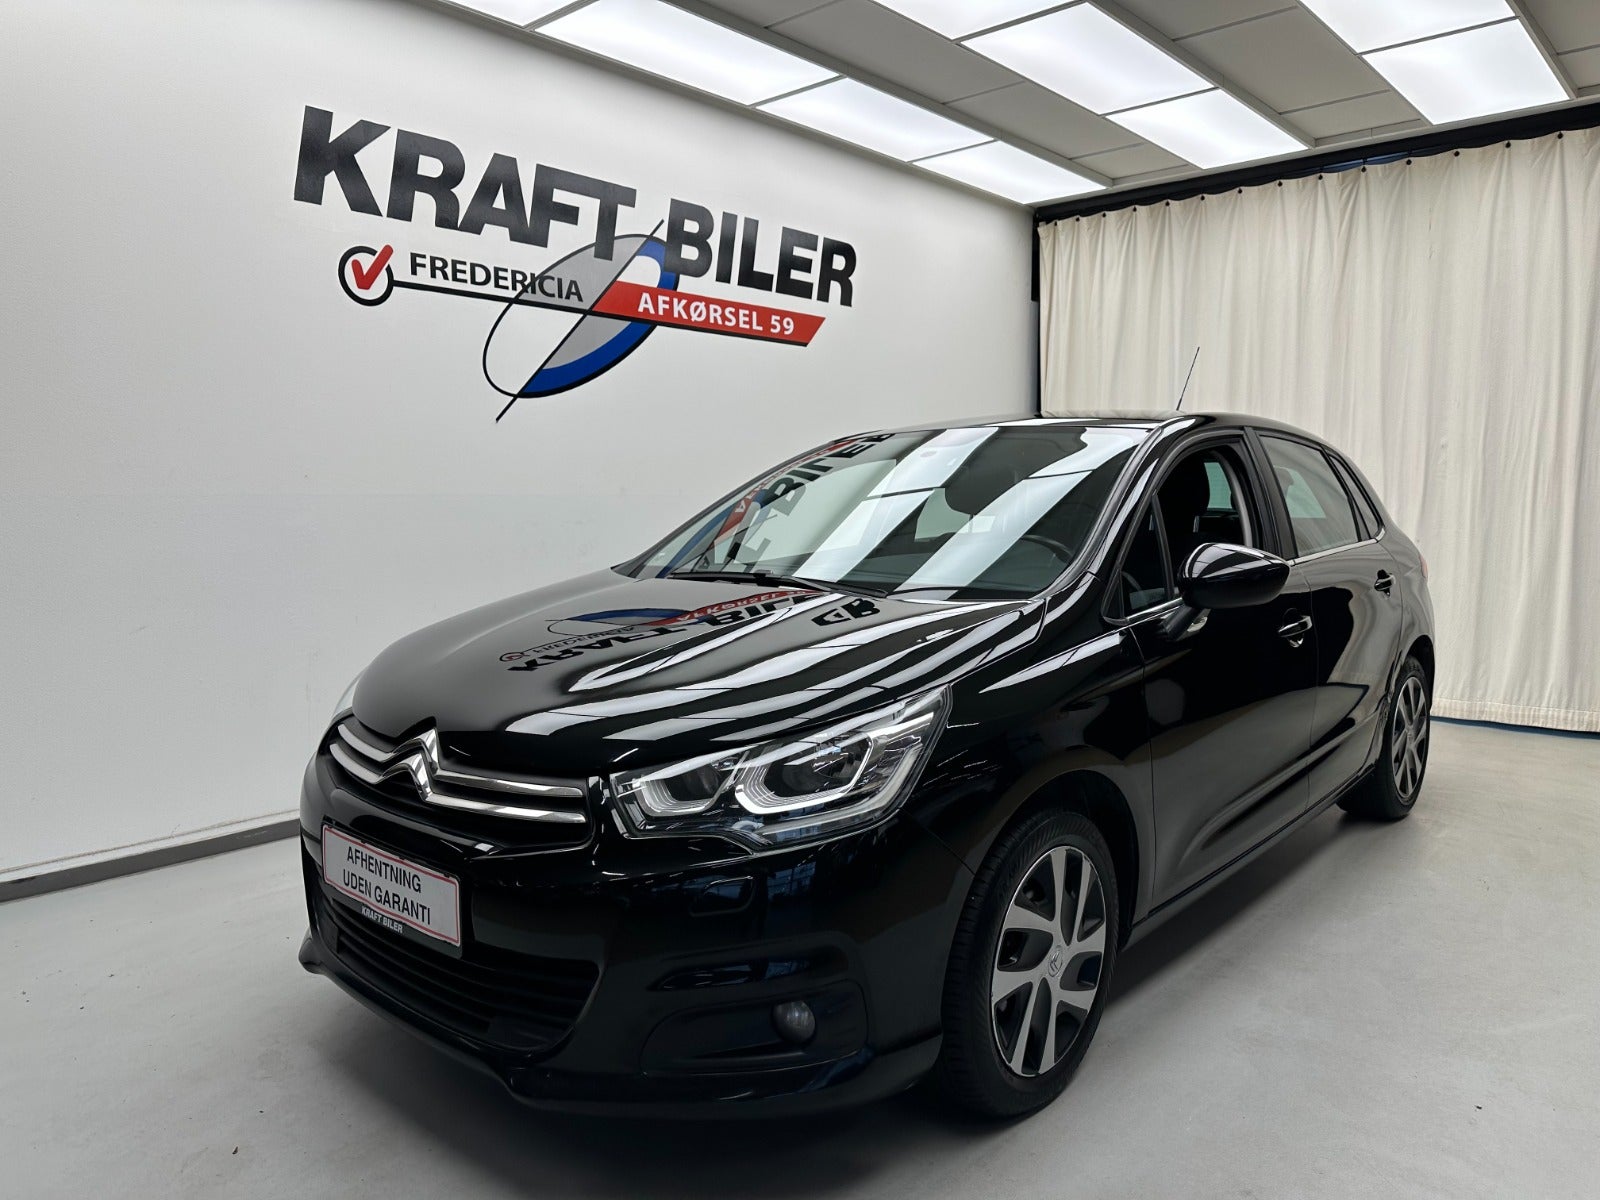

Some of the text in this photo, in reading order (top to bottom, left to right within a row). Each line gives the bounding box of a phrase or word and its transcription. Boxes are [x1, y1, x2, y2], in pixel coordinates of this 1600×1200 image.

[294, 105, 857, 307] KRAFT BILER
[409, 252, 584, 302] FREDERICIA
[637, 291, 796, 336] AFKØRSEL 59
[347, 846, 421, 893] AFHENTNING
[343, 868, 431, 925] UDEN GARANTI
[361, 905, 403, 934] KRAFT BILER
